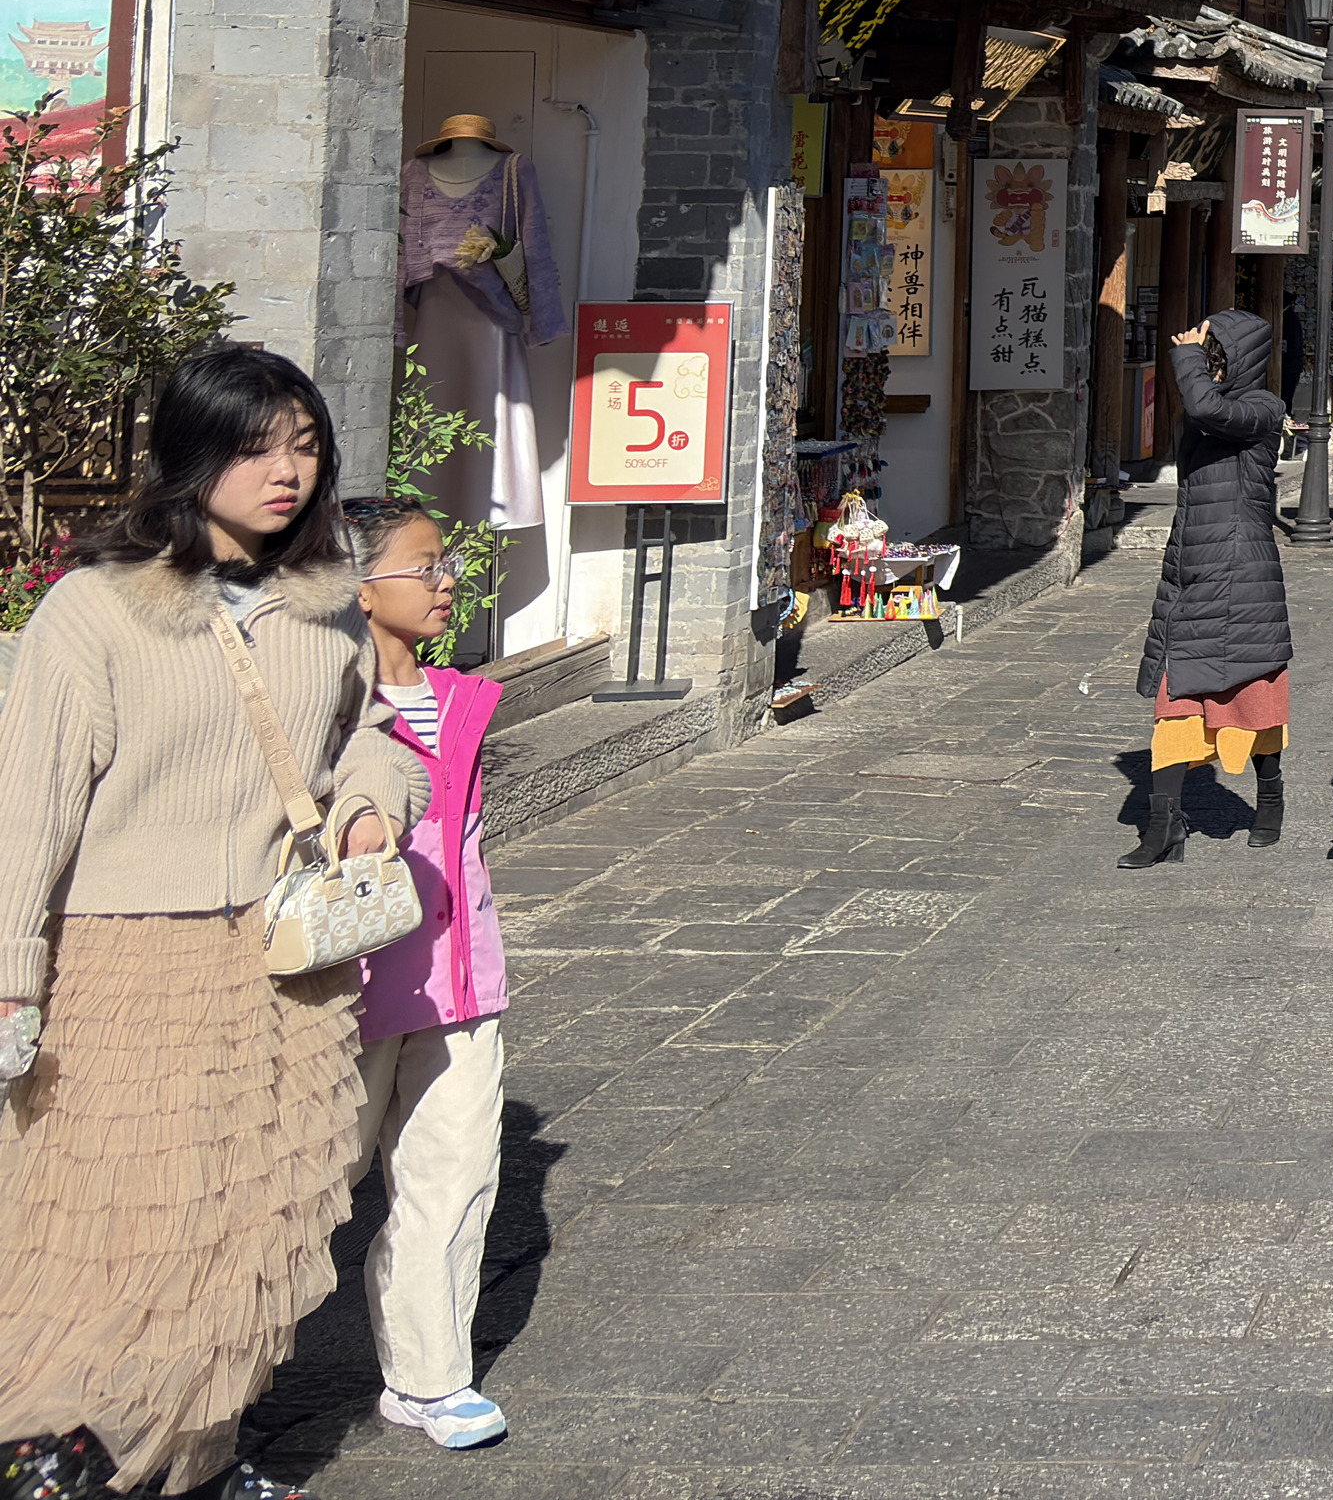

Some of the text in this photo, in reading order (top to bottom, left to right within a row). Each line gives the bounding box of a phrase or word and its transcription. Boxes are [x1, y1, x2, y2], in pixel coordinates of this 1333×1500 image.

[898, 243, 924, 348] 神兽相伴
[593, 318, 630, 332] 邂逅
[990, 288, 1014, 364] 有点甜
[1018, 276, 1048, 374] 瓦猫糕点
[607, 380, 622, 410] 全场
[626, 381, 666, 452] 5
[624, 458, 669, 468] 50%OFF
[672, 434, 686, 447] 折
